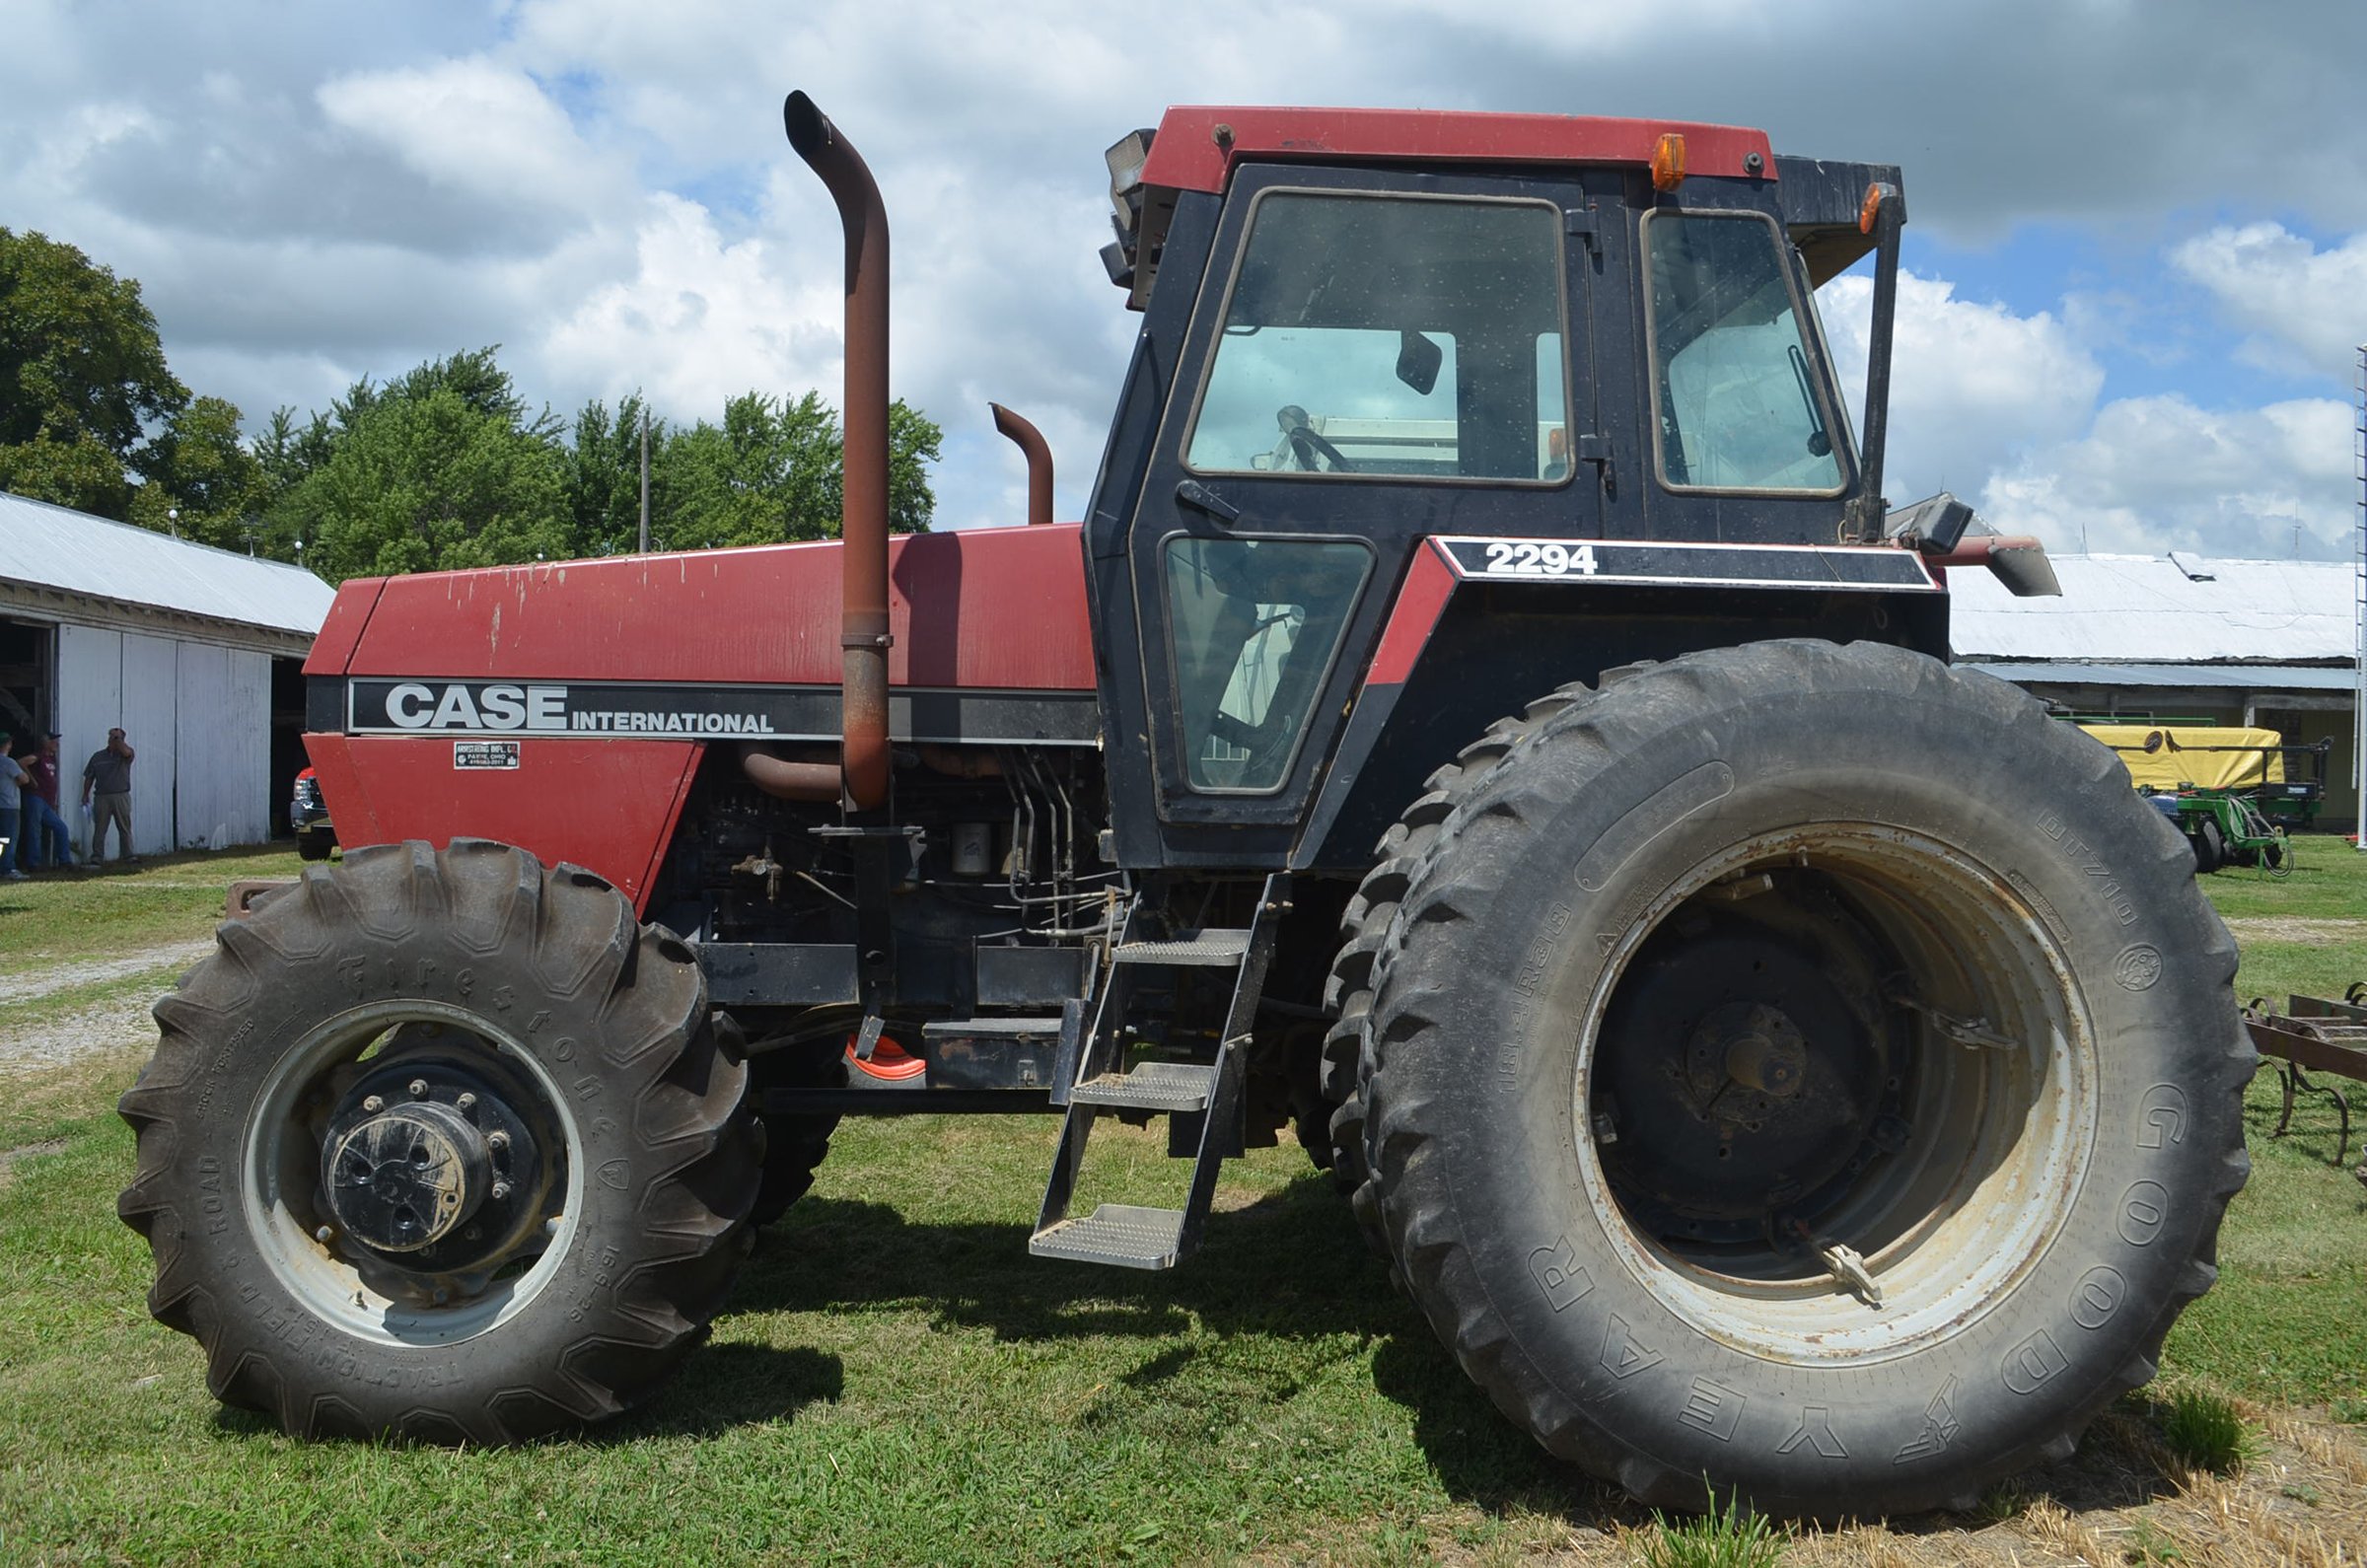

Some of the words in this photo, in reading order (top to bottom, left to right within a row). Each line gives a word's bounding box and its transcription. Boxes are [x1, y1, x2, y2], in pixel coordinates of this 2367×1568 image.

[1485, 543, 1598, 575] 2294
[385, 682, 568, 731] CASE
[572, 711, 774, 734] INTERNATIONAL
[1498, 902, 1572, 1095] 18.4R38
[337, 954, 616, 1141] Firestone
[199, 1156, 230, 1236] ROAD
